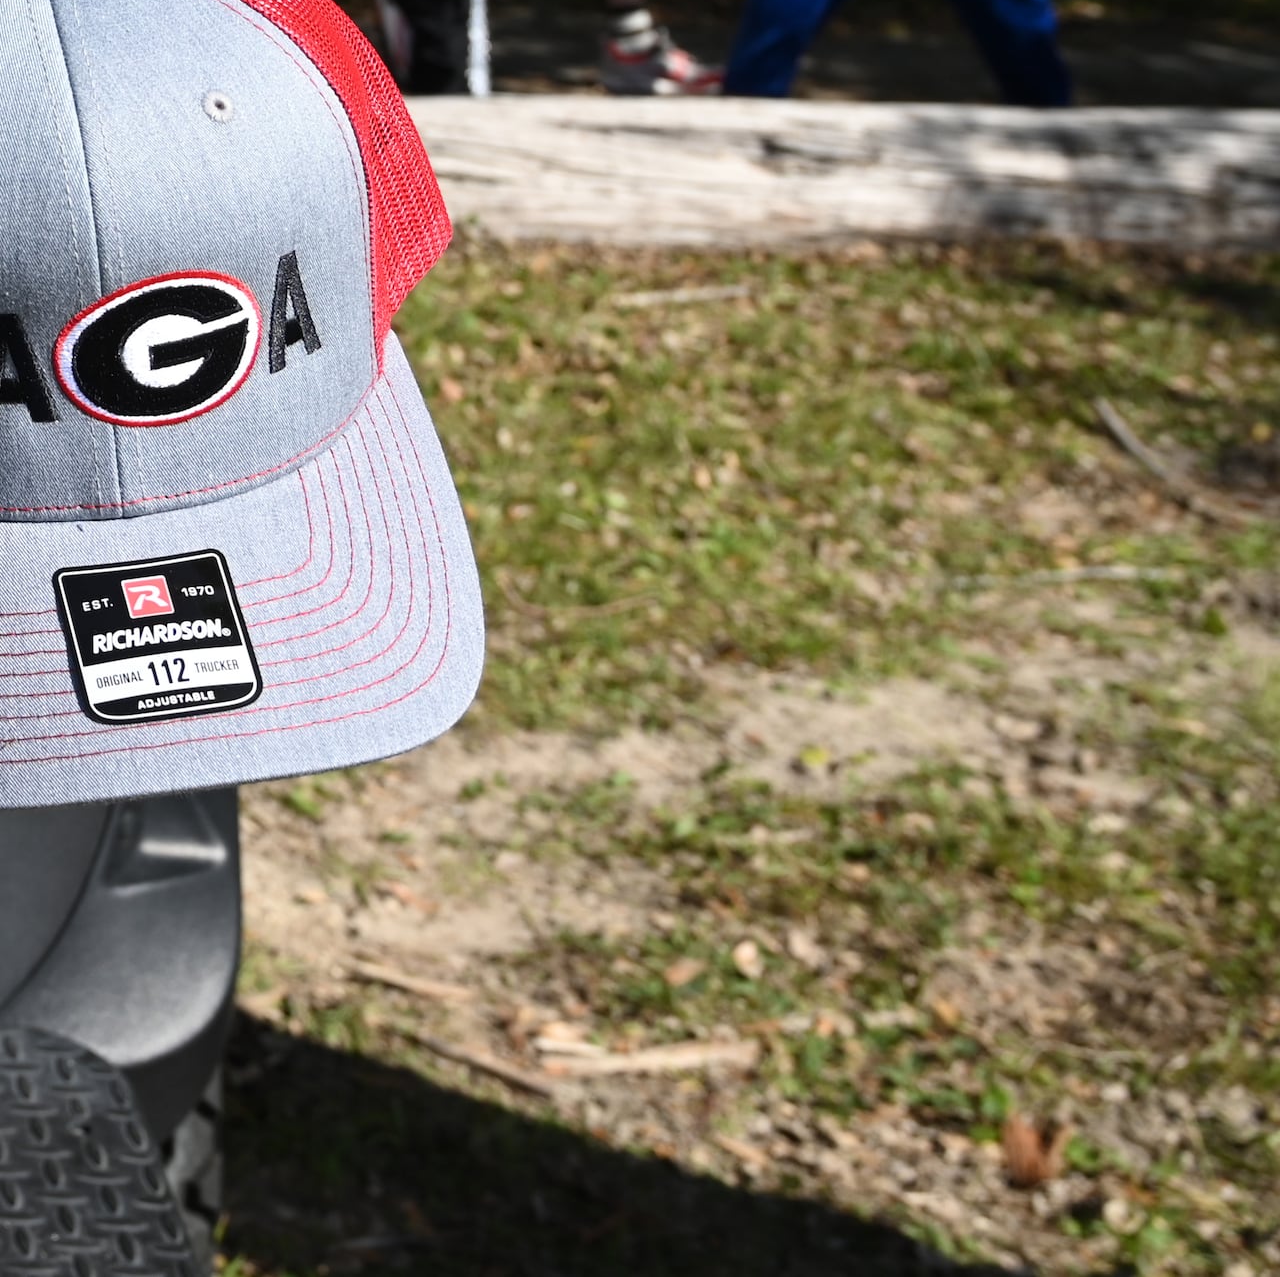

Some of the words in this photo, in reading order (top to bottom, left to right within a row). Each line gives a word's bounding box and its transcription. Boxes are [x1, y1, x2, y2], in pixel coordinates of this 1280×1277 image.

[81, 598, 114, 612] EST.
[180, 585, 215, 598] 1970
[96, 670, 143, 689] ORIGINAL
[147, 657, 190, 686] 112
[194, 659, 240, 674] TRUCKER
[137, 690, 216, 710] ADJUSTABLE
